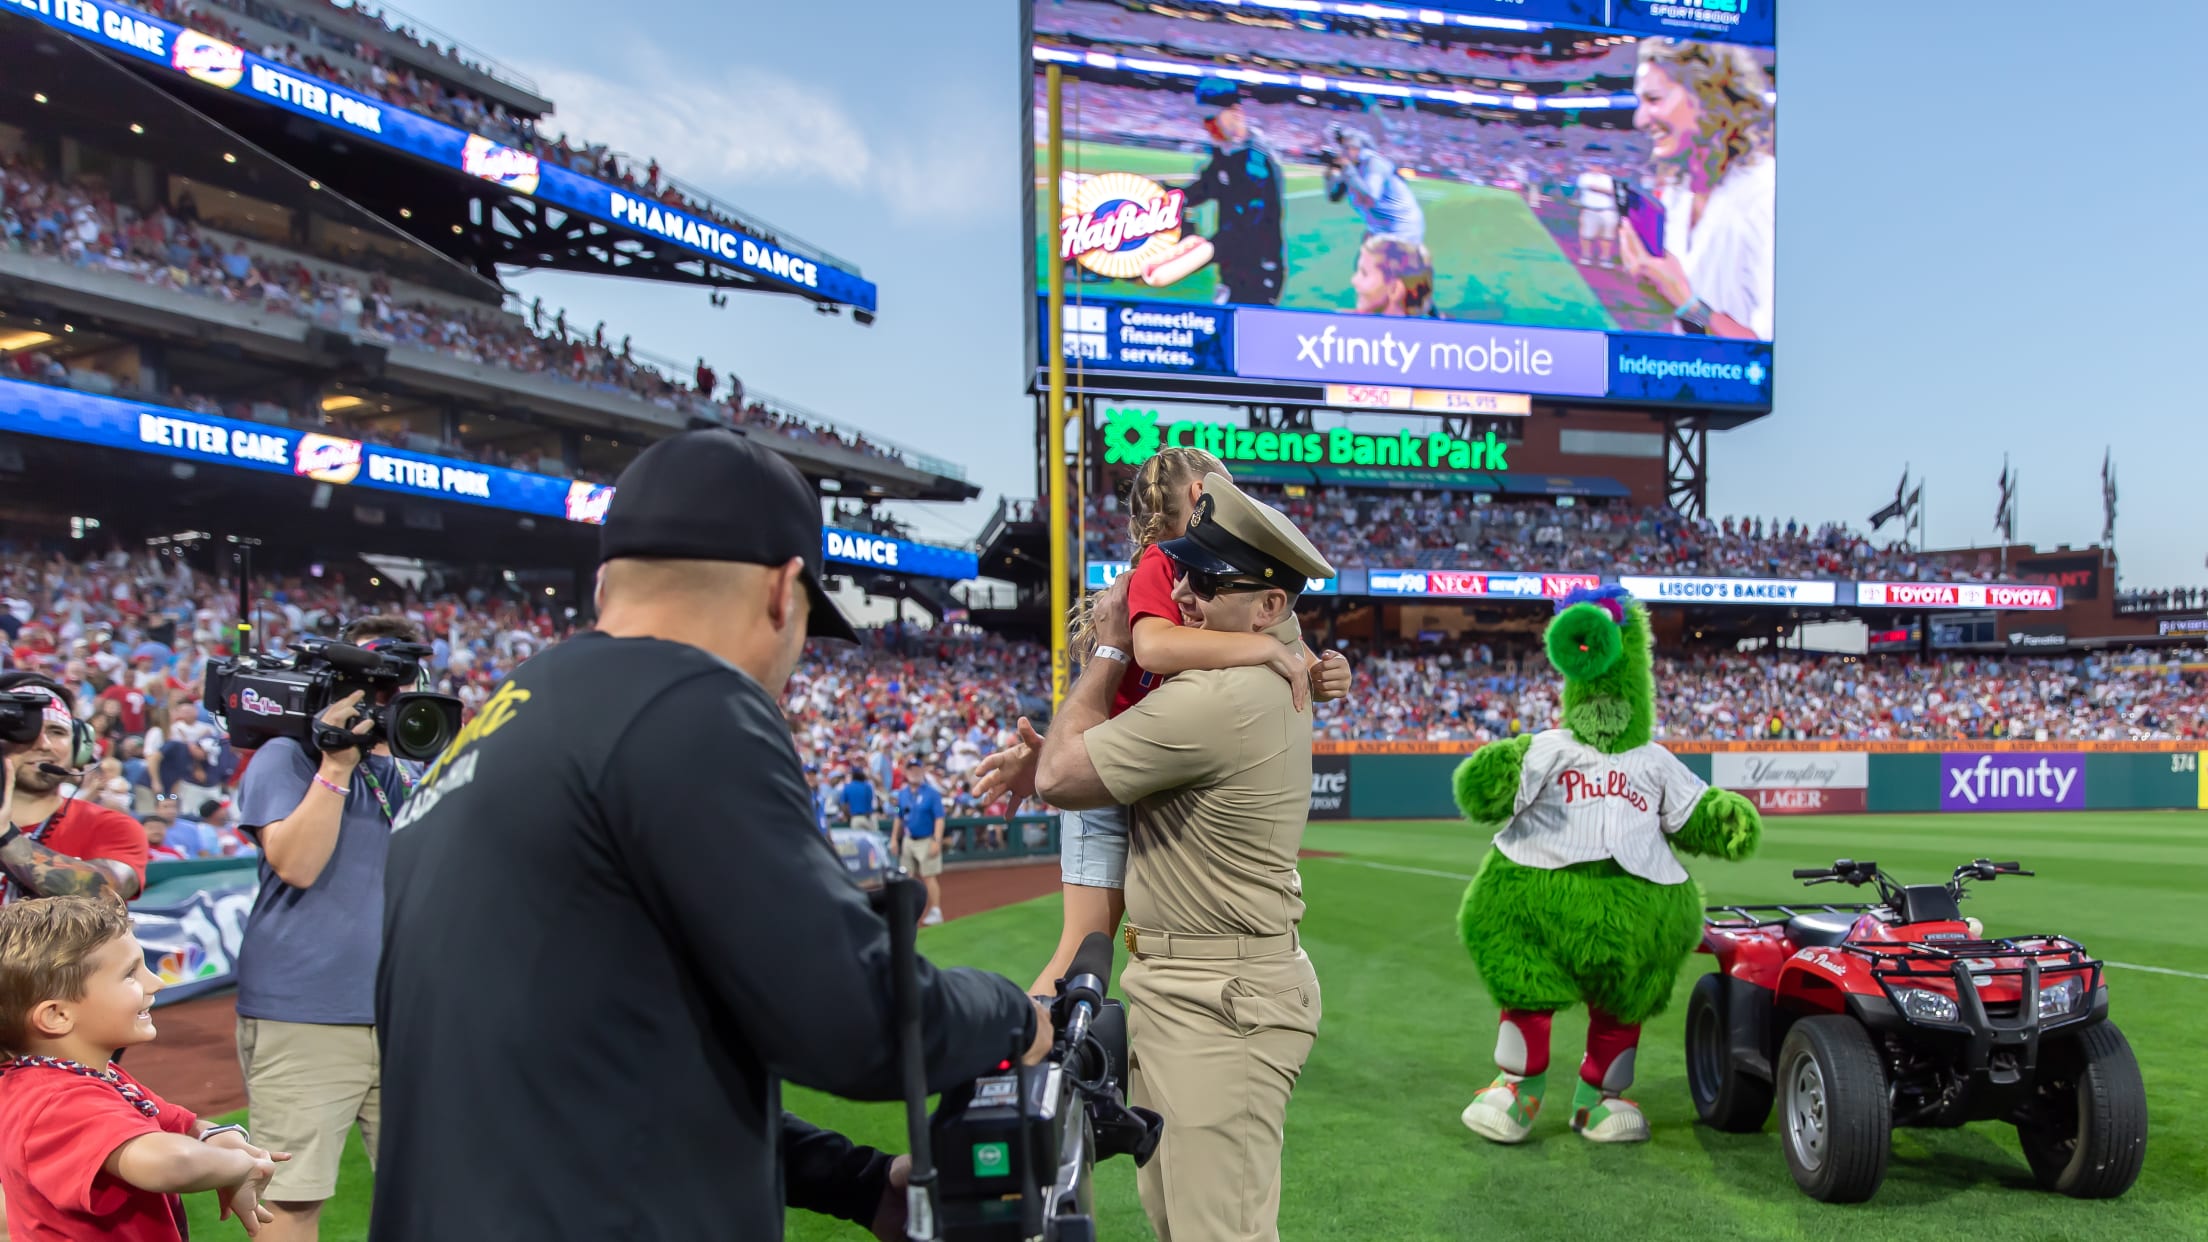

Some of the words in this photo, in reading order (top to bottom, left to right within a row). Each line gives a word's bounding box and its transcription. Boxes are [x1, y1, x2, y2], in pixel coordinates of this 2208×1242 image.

[103, 9, 166, 57] CARE
[251, 63, 328, 114] BETTER
[330, 92, 382, 134] PORK
[610, 191, 738, 259] PHANATIC
[742, 239, 818, 287] DANCE
[1060, 188, 1185, 261] Hatfield
[1119, 307, 1216, 335] Connecting
[1119, 326, 1194, 348] financial
[1119, 346, 1195, 366] services.
[1296, 324, 1420, 374] xfinity
[1430, 336, 1554, 376] mobile
[1618, 354, 1743, 380] Independence
[139, 413, 229, 456] BETTER
[231, 429, 289, 465] CARE
[1166, 420, 1323, 464] Citizens
[1328, 427, 1423, 466] Bank
[1427, 431, 1508, 470] Park
[368, 453, 441, 490] BETTER
[442, 467, 491, 499] PORK
[827, 532, 899, 566] DANCE
[1433, 574, 1484, 595] NECA
[1658, 582, 1729, 598] LISCIO'S
[1733, 584, 1798, 599] BAKERY
[1890, 585, 1954, 604] TOYOTA
[1989, 587, 2052, 606] TOYOTA
[1949, 755, 2078, 804] xfinity
[2171, 753, 2196, 772] 374
[1557, 770, 1648, 812] Phillies
[1759, 790, 1822, 809] LAGER
